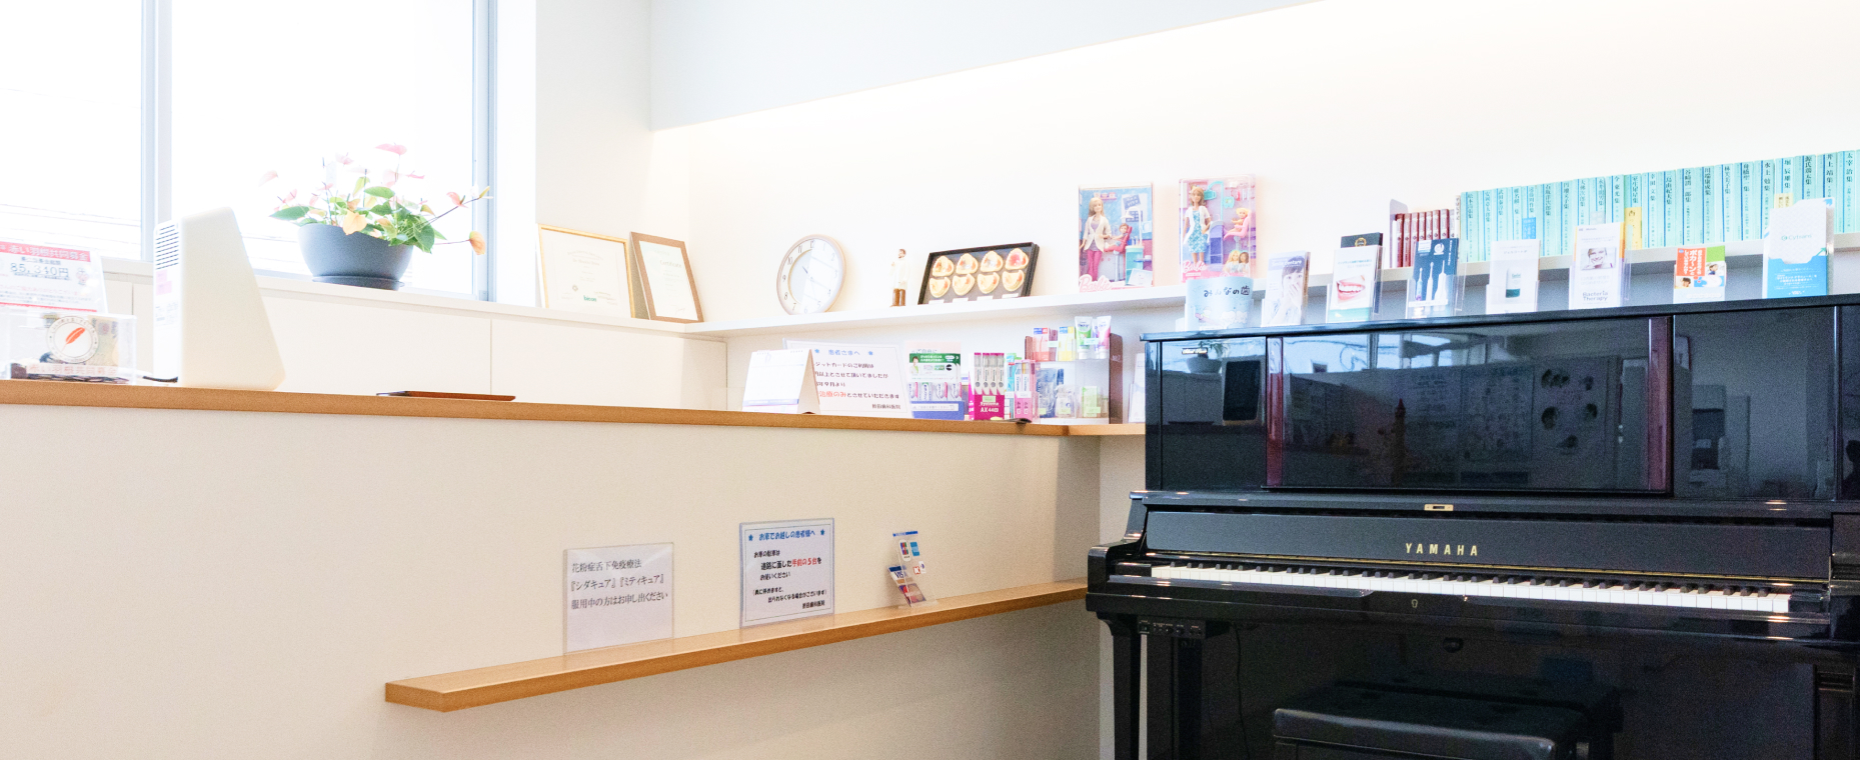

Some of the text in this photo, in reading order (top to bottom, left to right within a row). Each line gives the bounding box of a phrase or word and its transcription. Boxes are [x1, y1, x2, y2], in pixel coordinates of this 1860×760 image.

[9, 244, 89, 261] 赤い羽根共同募金
[1181, 260, 1207, 272] Barbie
[1079, 273, 1113, 293] Barbie
[759, 530, 816, 541] お車でお越しの患者様へ
[1405, 543, 1478, 556] YAMAHA
[571, 559, 642, 573] 花粉症舌下免疫療法
[571, 592, 669, 609] 服用中の方はお申し出ください
